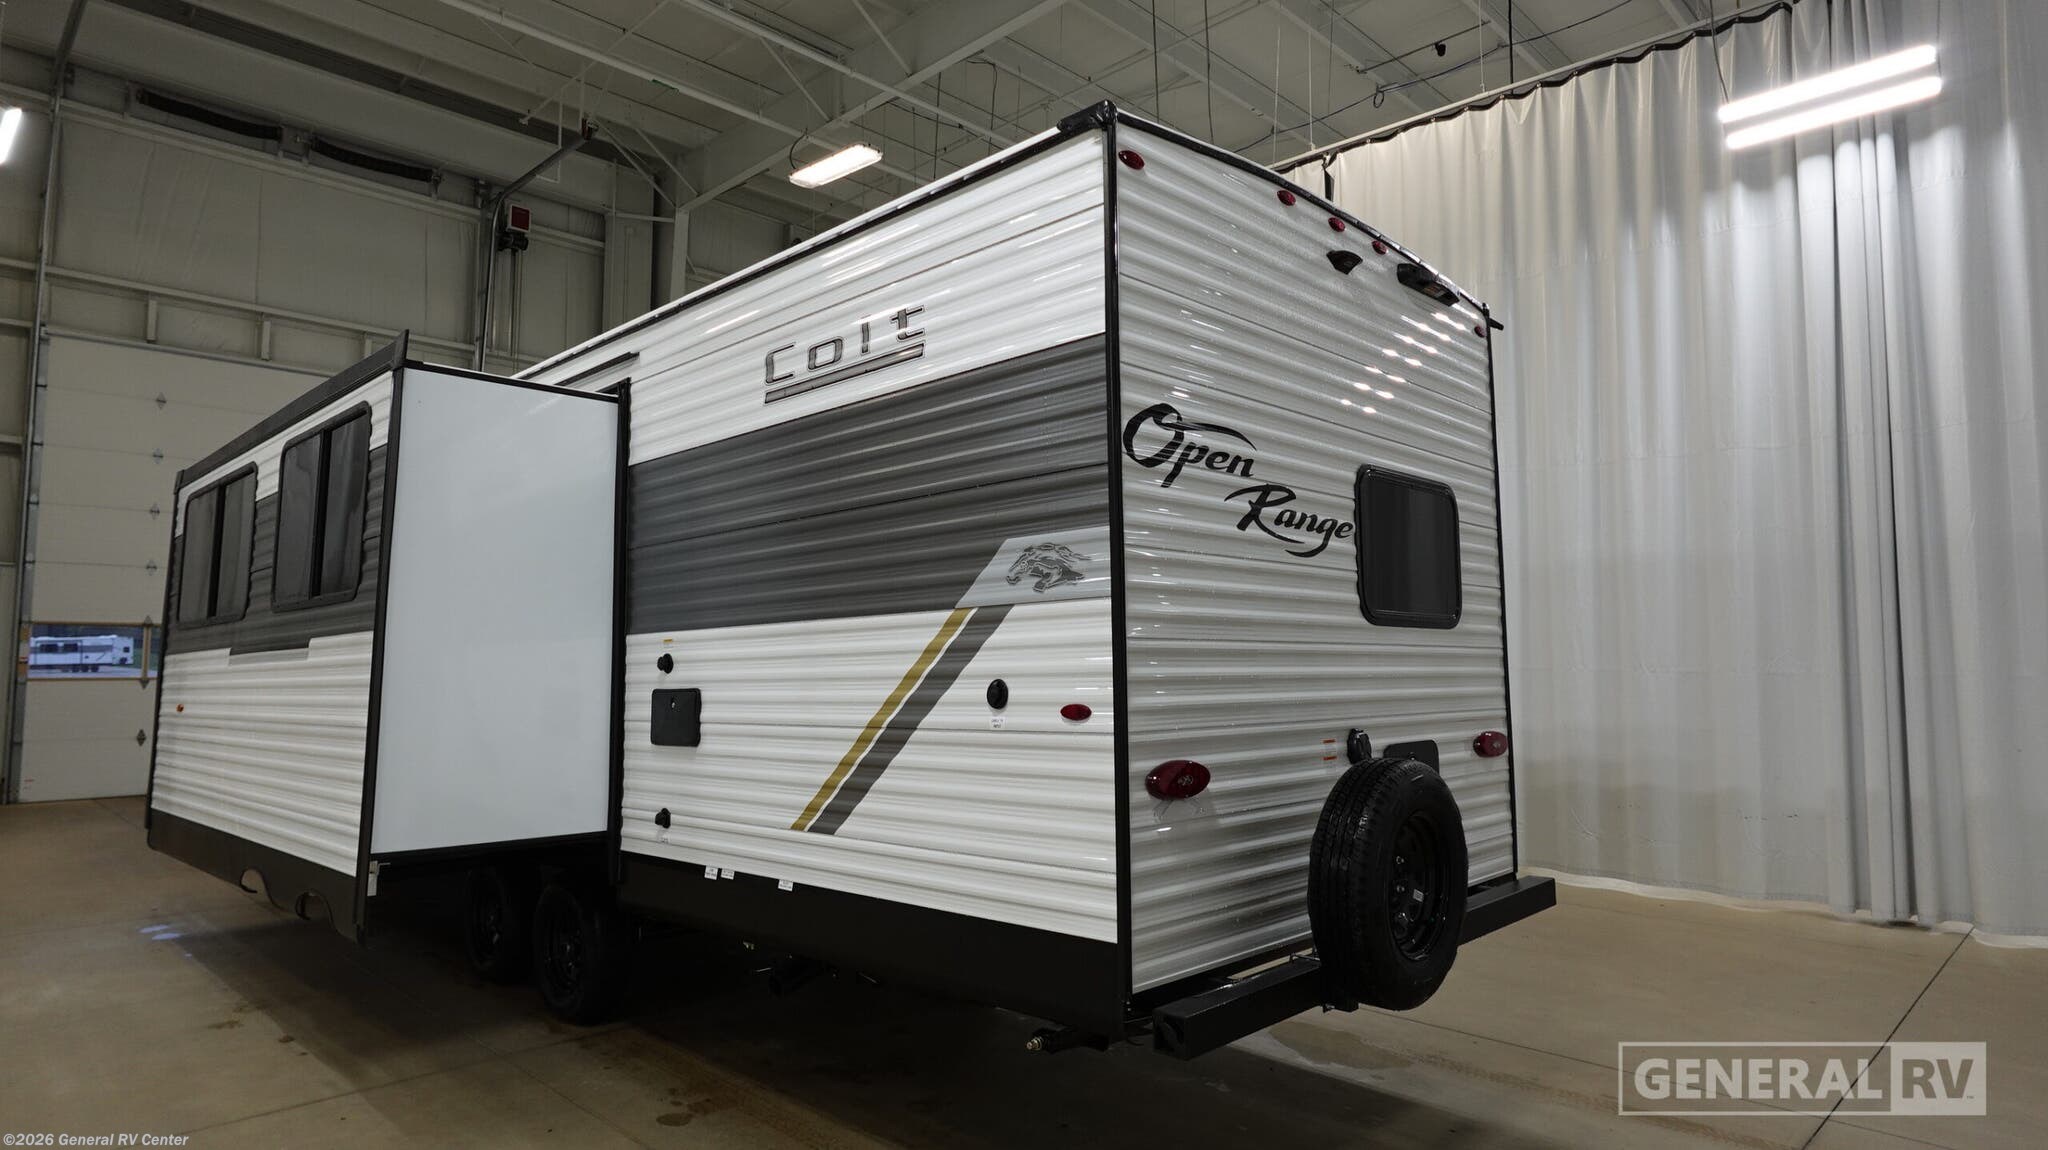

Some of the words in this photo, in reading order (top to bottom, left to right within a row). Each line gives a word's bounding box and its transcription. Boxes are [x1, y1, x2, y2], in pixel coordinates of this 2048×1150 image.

[764, 305, 926, 385] Colt
[1123, 402, 1257, 488] Open
[1224, 483, 1353, 558] Range
